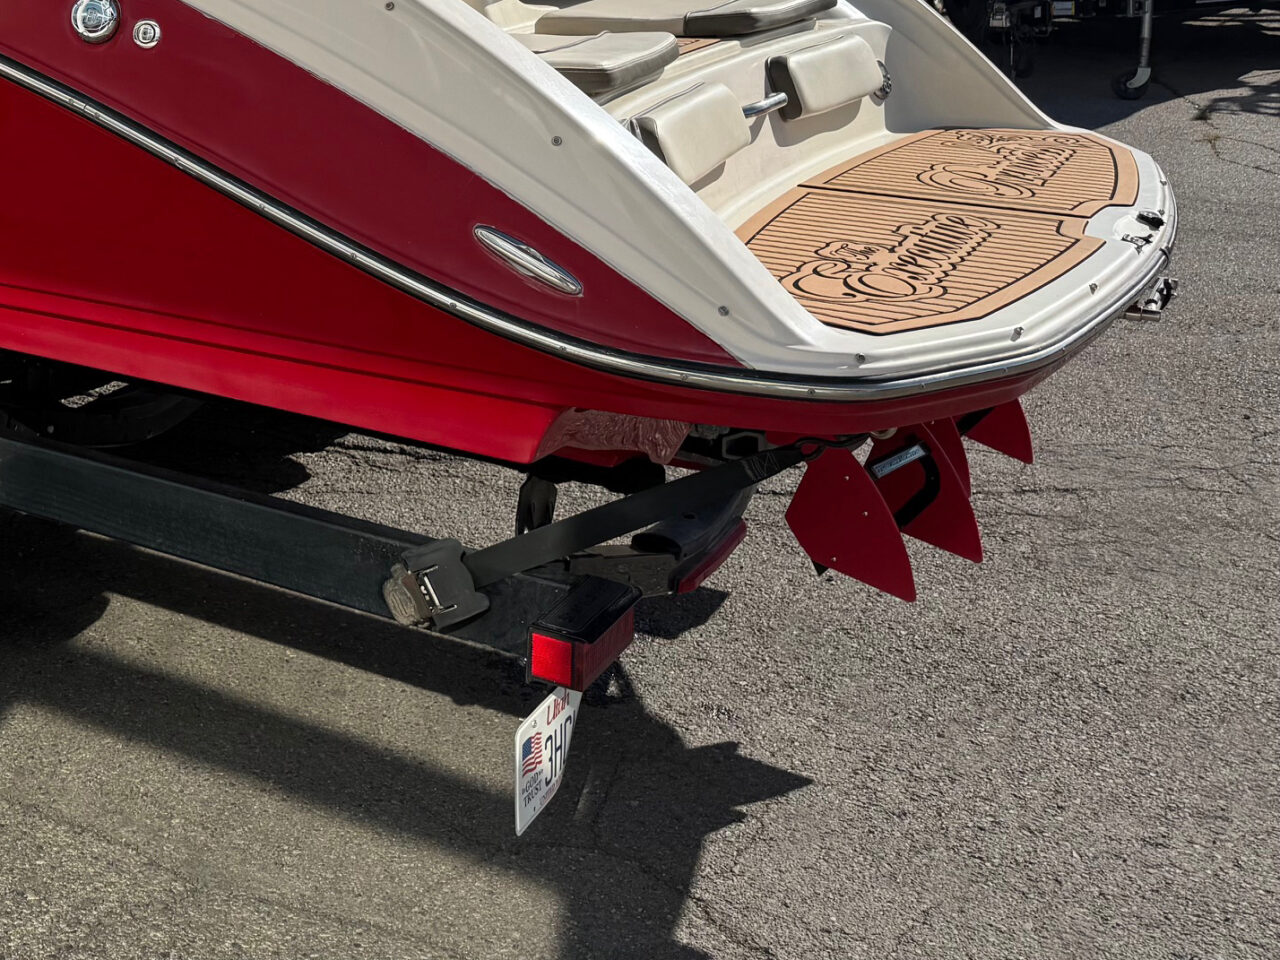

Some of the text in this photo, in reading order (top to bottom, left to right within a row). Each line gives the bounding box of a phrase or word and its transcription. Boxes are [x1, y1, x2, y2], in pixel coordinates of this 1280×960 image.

[792, 215, 988, 300] Executive
[829, 242, 881, 261] The
[546, 687, 570, 726] Utah
[523, 779, 542, 808] TRUST
